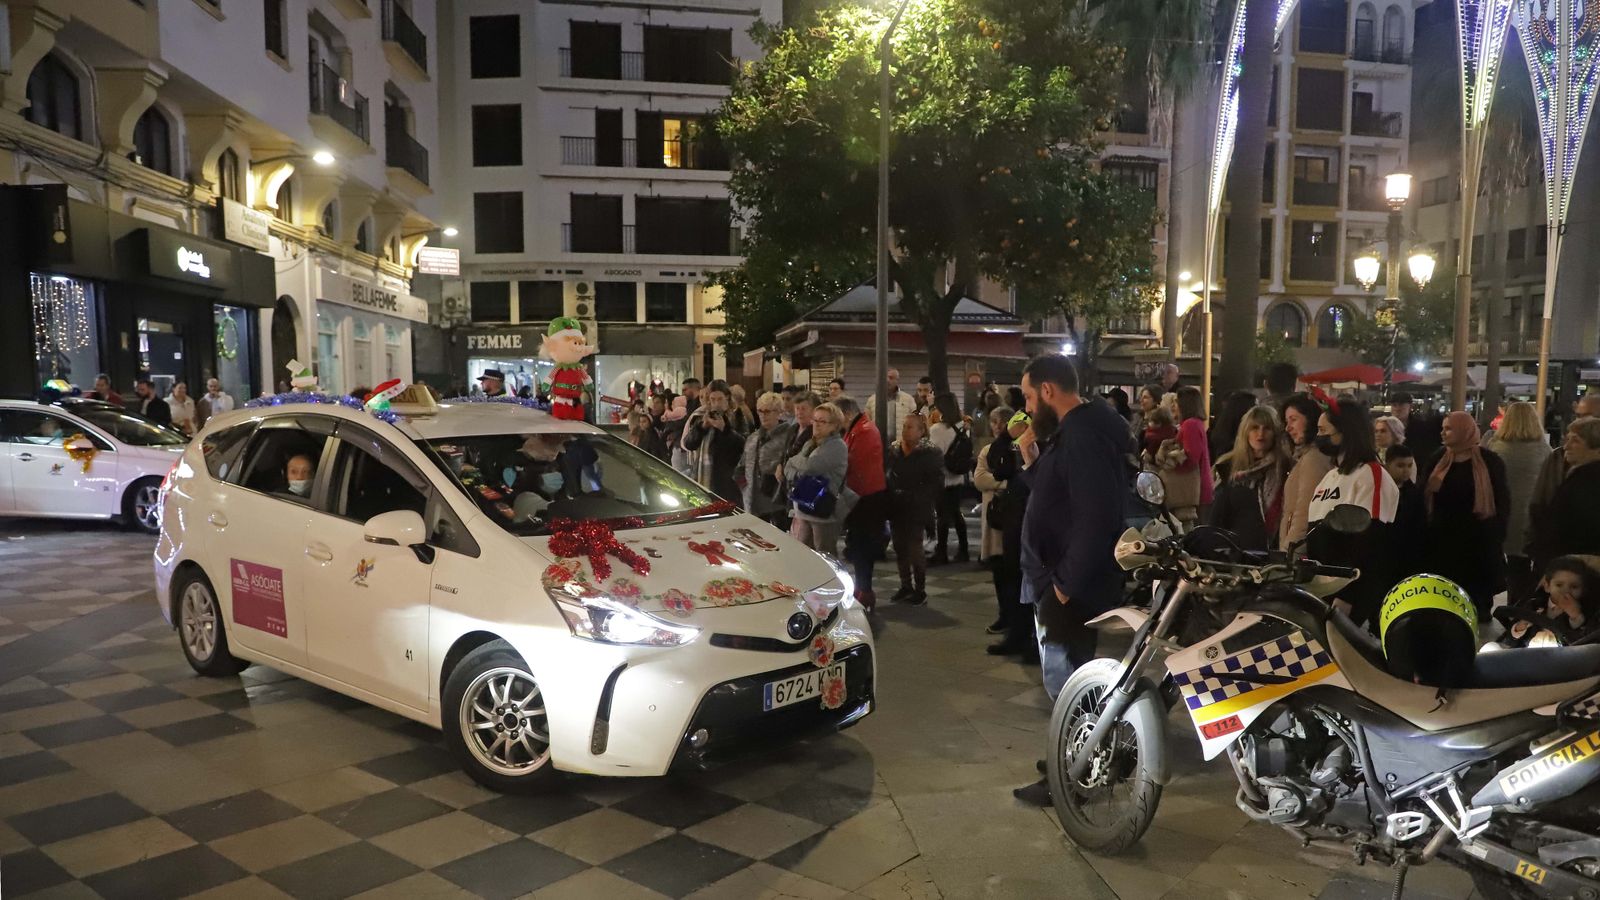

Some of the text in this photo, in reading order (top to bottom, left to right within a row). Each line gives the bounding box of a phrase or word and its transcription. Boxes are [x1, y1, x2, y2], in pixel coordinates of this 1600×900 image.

[604, 268, 642, 276] ABOGADOS
[352, 282, 398, 312] BELLAFEMME
[466, 334, 523, 350] FEMME
[1311, 486, 1341, 502] FILA
[1385, 585, 1472, 620] POLICIA LOCA
[404, 648, 413, 662] 41
[775, 675, 813, 704] 6724
[1214, 717, 1237, 731] 112
[1507, 732, 1600, 791] POLICIA L
[1520, 862, 1543, 881] 14
